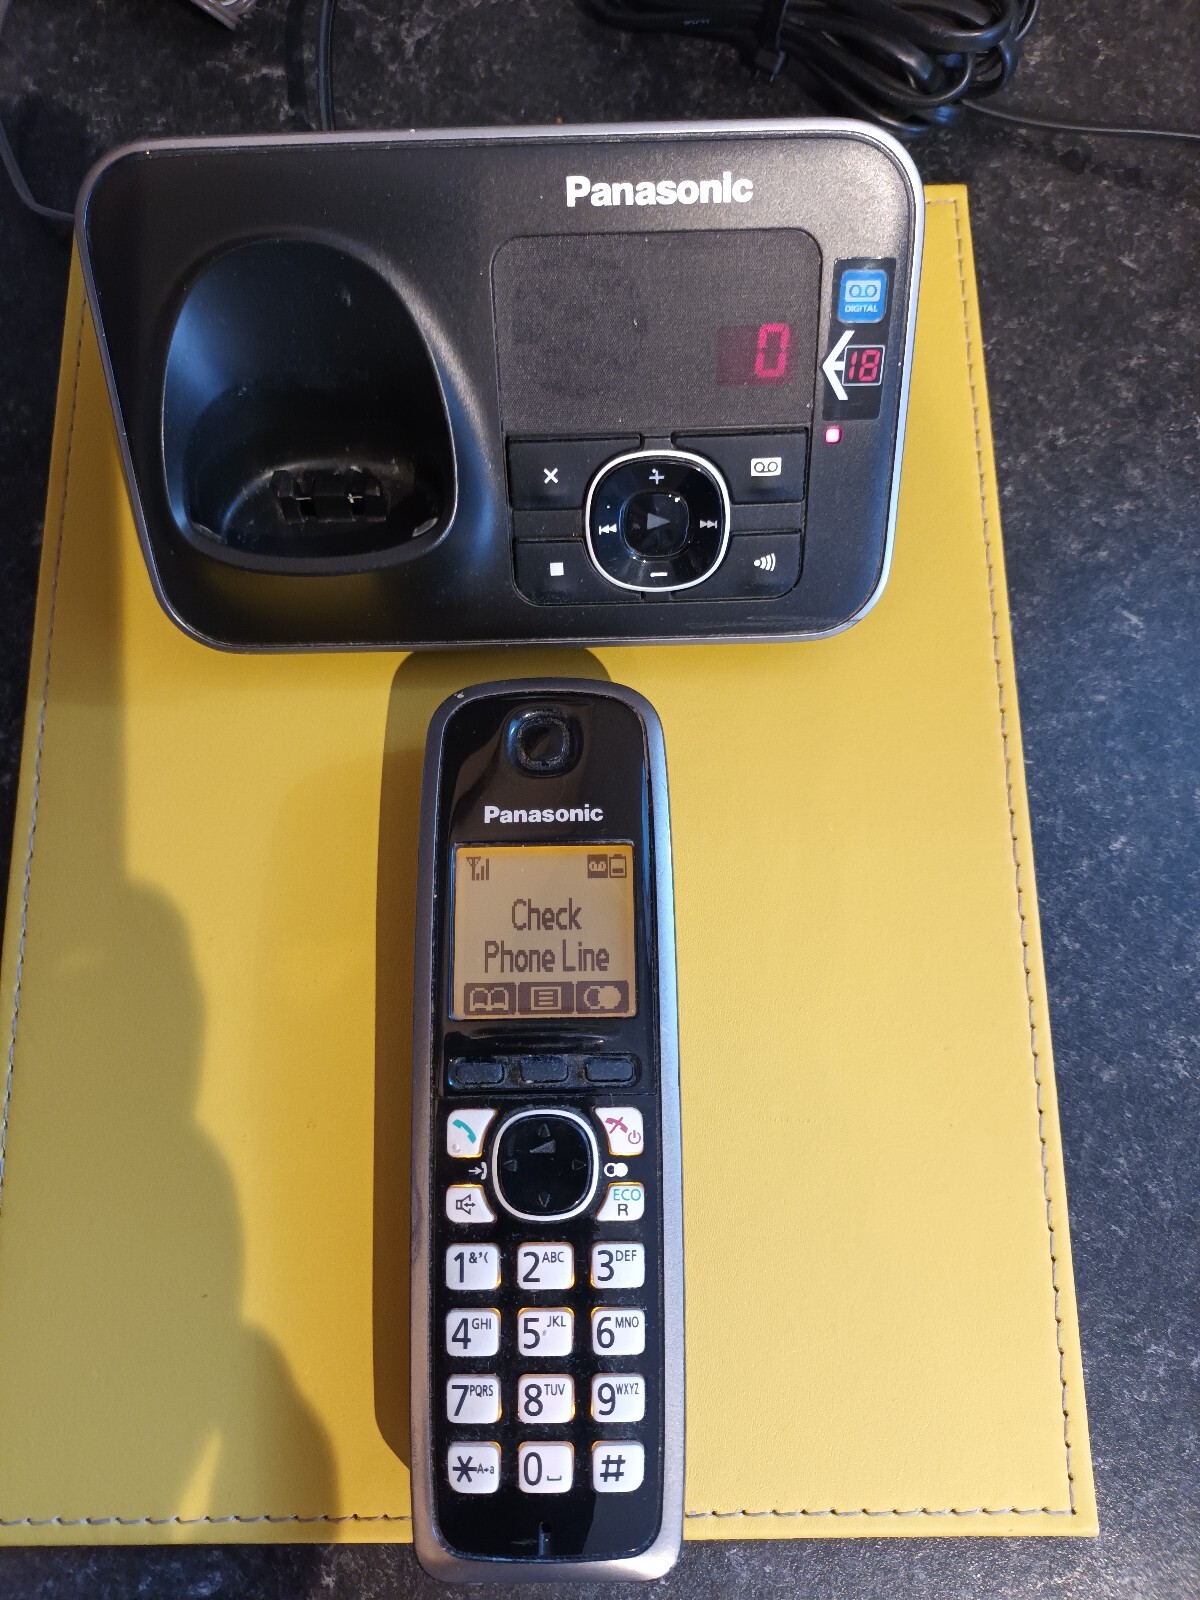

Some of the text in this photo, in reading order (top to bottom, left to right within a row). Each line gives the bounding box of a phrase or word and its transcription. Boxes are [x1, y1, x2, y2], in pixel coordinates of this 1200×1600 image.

[565, 171, 754, 208] Panasonic
[844, 304, 878, 314] DIGITAL
[754, 323, 790, 378] 0
[848, 349, 881, 382] 18
[484, 804, 604, 823] Panasonic
[511, 898, 582, 930] Check
[484, 939, 610, 973] Phone Line
[613, 1188, 642, 1201] ECO
[617, 1203, 629, 1217] R
